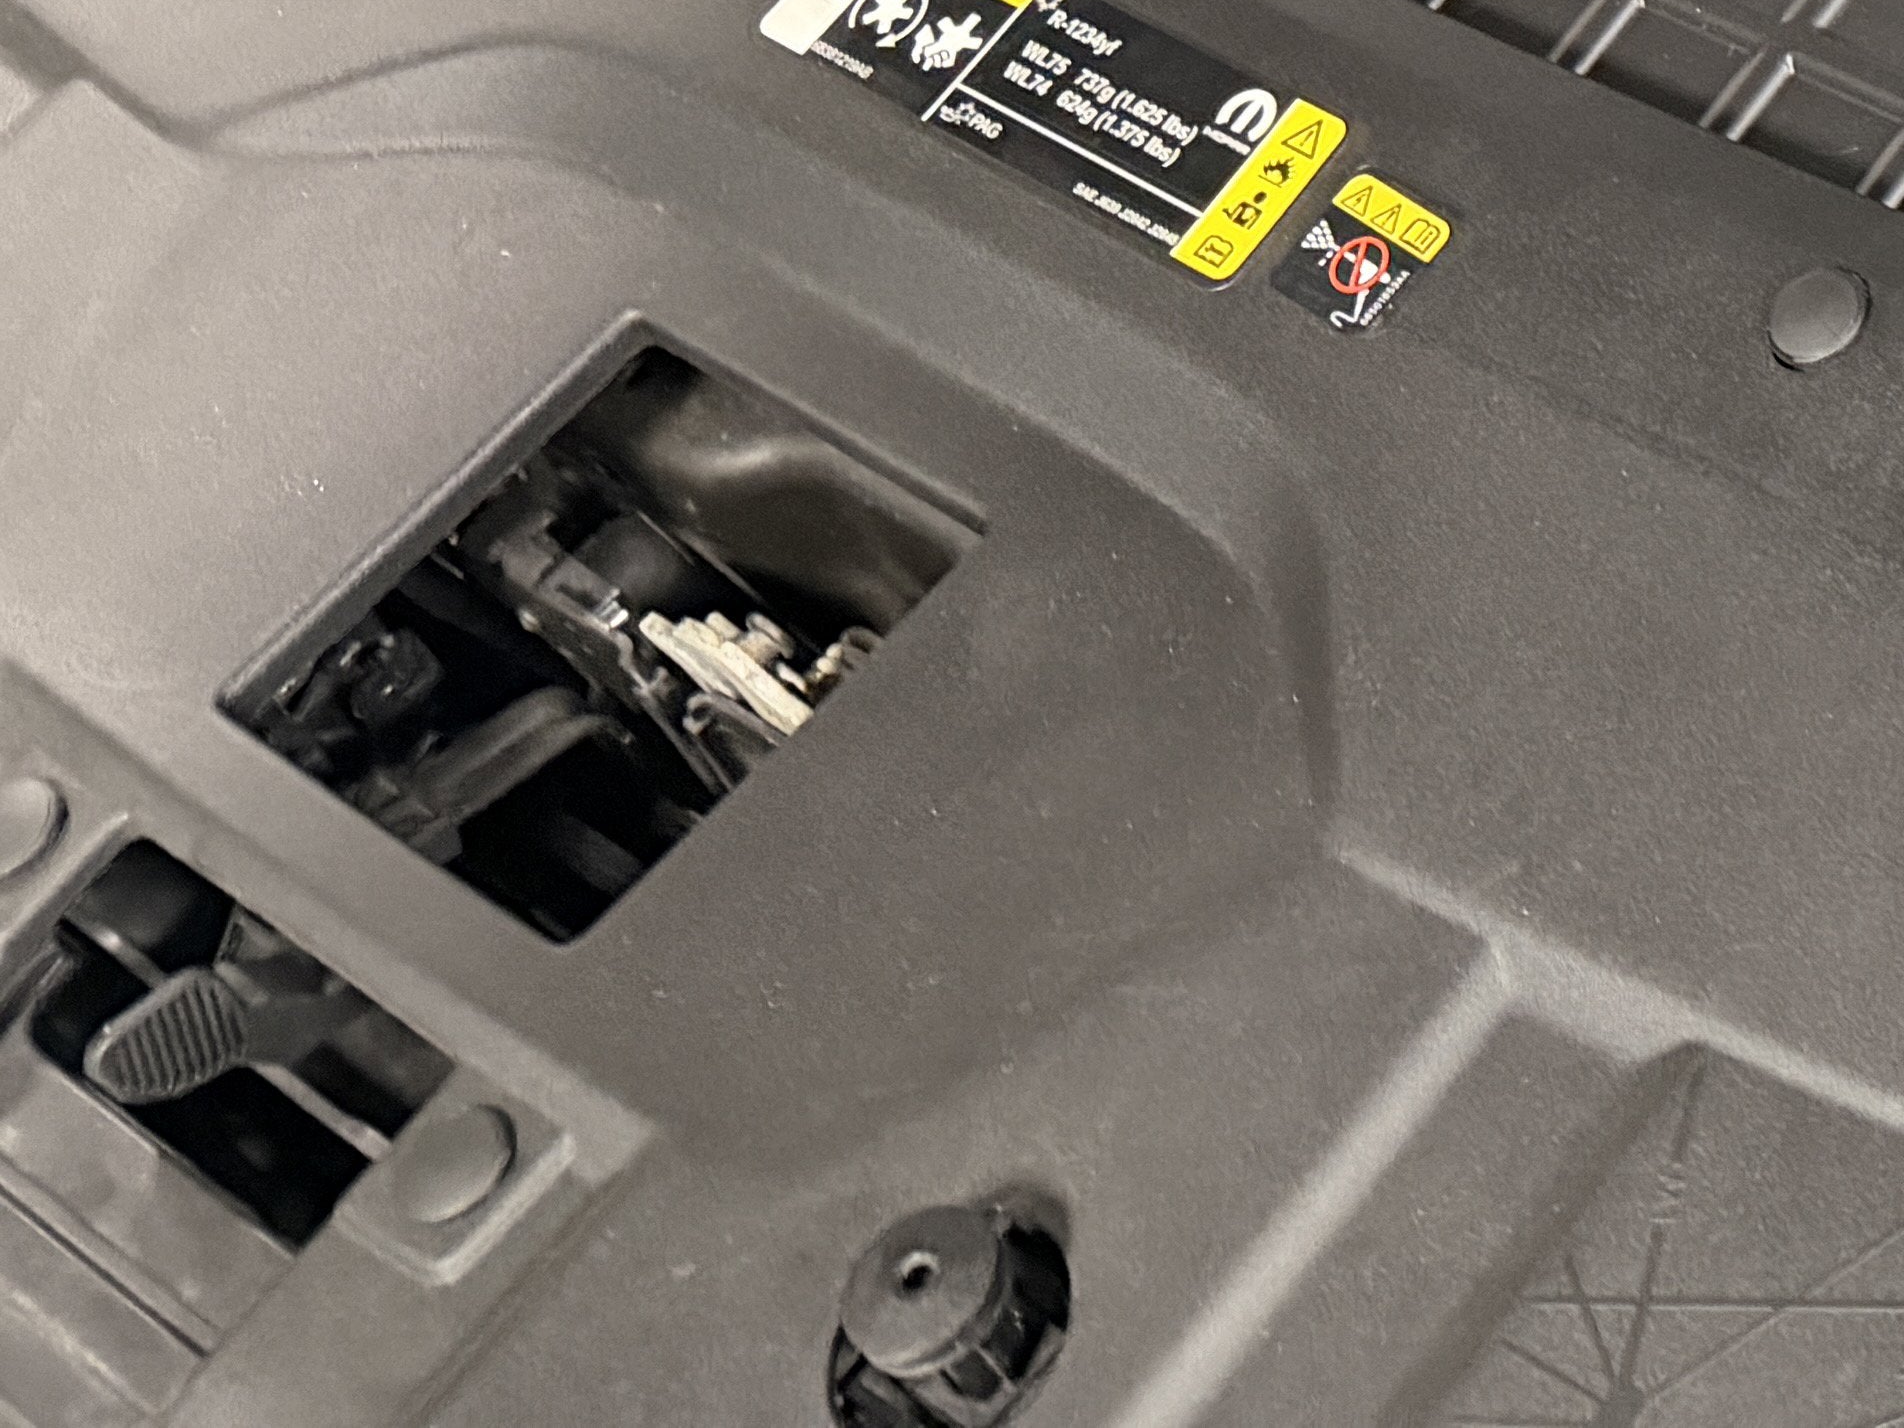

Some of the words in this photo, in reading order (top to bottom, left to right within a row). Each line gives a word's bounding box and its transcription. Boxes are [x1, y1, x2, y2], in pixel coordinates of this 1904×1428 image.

[1047, 9, 1123, 56] R-1234yf
[968, 111, 1003, 140] PAG
[1003, 60, 1054, 96] WL74
[1056, 89, 1099, 126] 624g
[1092, 110, 1150, 148] (1.375
[1143, 135, 1182, 168] lbs)
[1021, 39, 1072, 76] WL75
[1074, 67, 1117, 104] 737g
[1111, 89, 1168, 126] (1.625
[1161, 113, 1199, 147] lbs)
